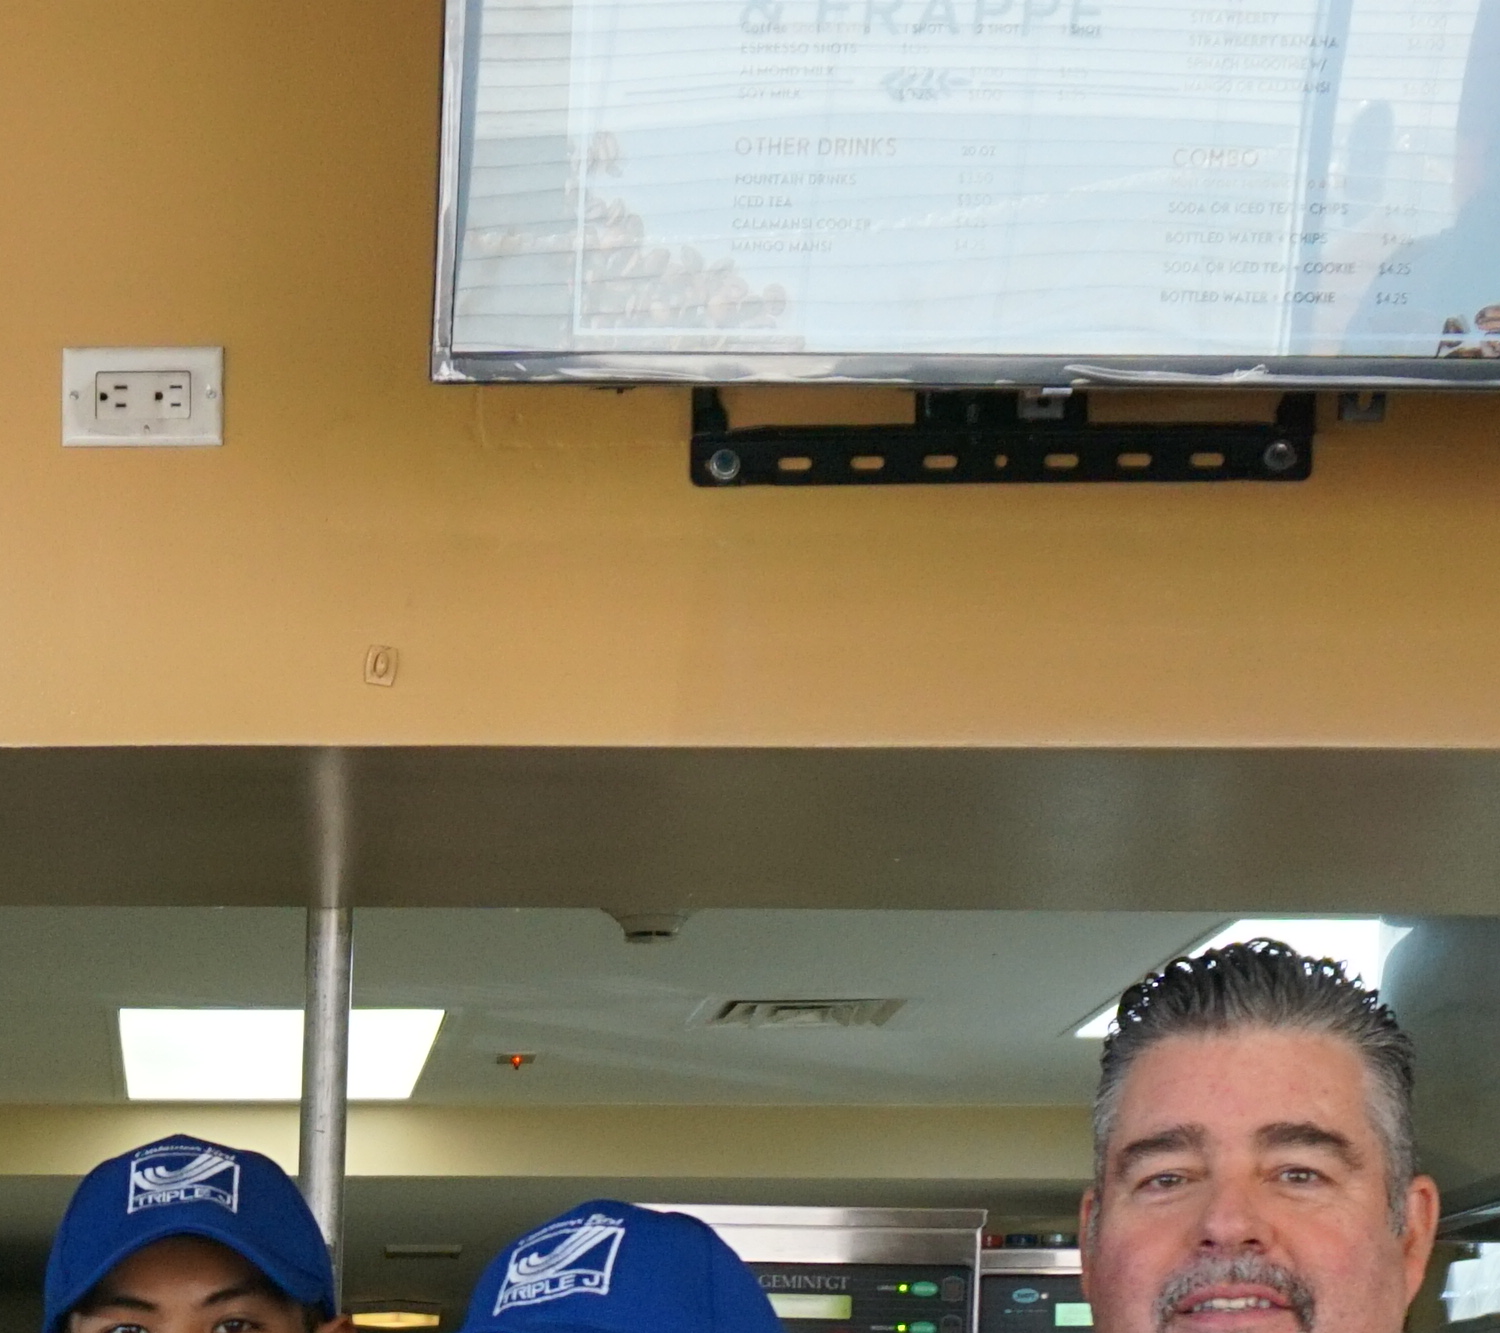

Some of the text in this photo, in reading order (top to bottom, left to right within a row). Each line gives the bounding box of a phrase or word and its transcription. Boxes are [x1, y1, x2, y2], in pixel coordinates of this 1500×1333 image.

[734, 136, 898, 158] OTHER DRINKS
[1171, 148, 1260, 169] COMBO
[767, 195, 793, 208] TEA
[1168, 202, 1349, 216] SODA ICED CHIPS
[1165, 231, 1274, 245] BOTTLED WATER
[1163, 261, 1358, 275] SODA ICED COOKIE
[1160, 291, 1269, 304] BOTTLED WATER
[138, 1187, 233, 1207] TRIPLE J
[503, 1272, 601, 1304] TRIPLE J
